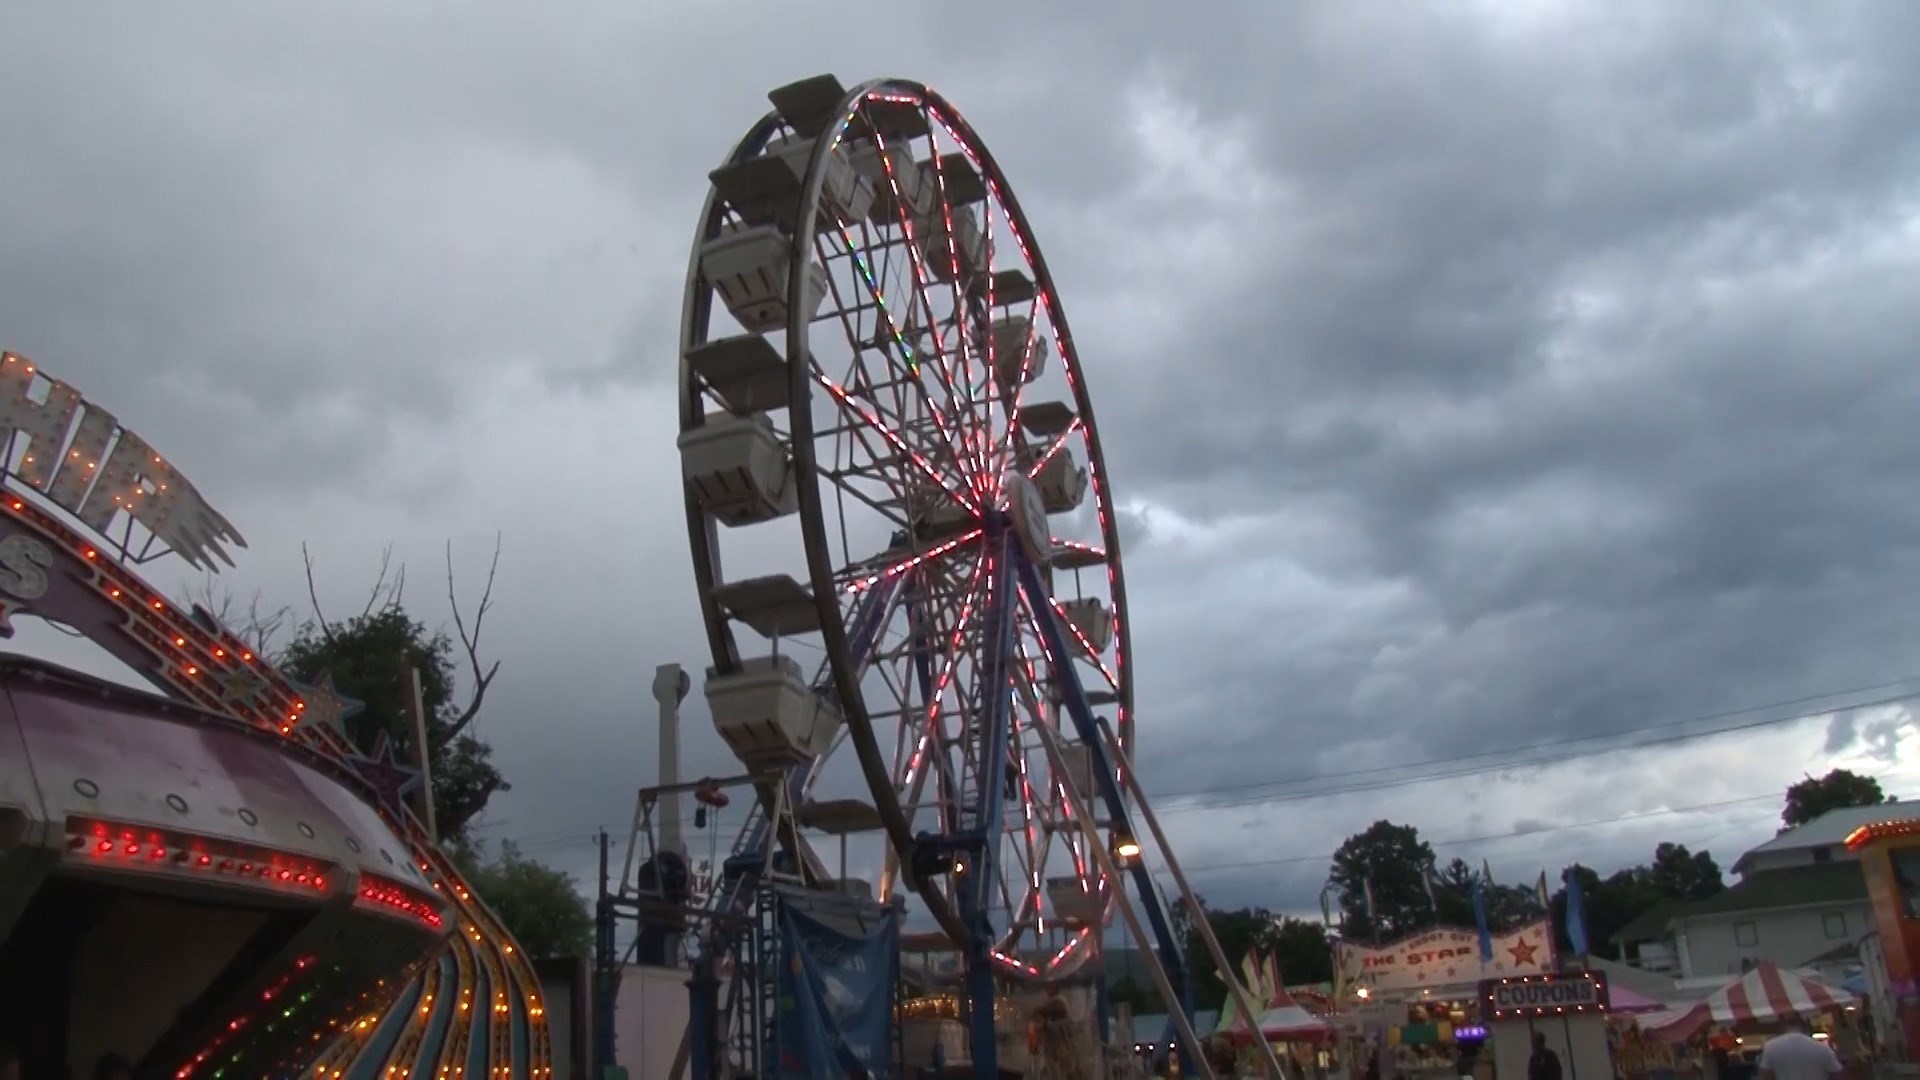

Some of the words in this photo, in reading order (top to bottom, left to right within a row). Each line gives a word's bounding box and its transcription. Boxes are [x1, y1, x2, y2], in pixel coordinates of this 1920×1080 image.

[1364, 954, 1395, 966] THE
[1407, 947, 1471, 965] STAR
[1497, 982, 1592, 1005] COUPONS
